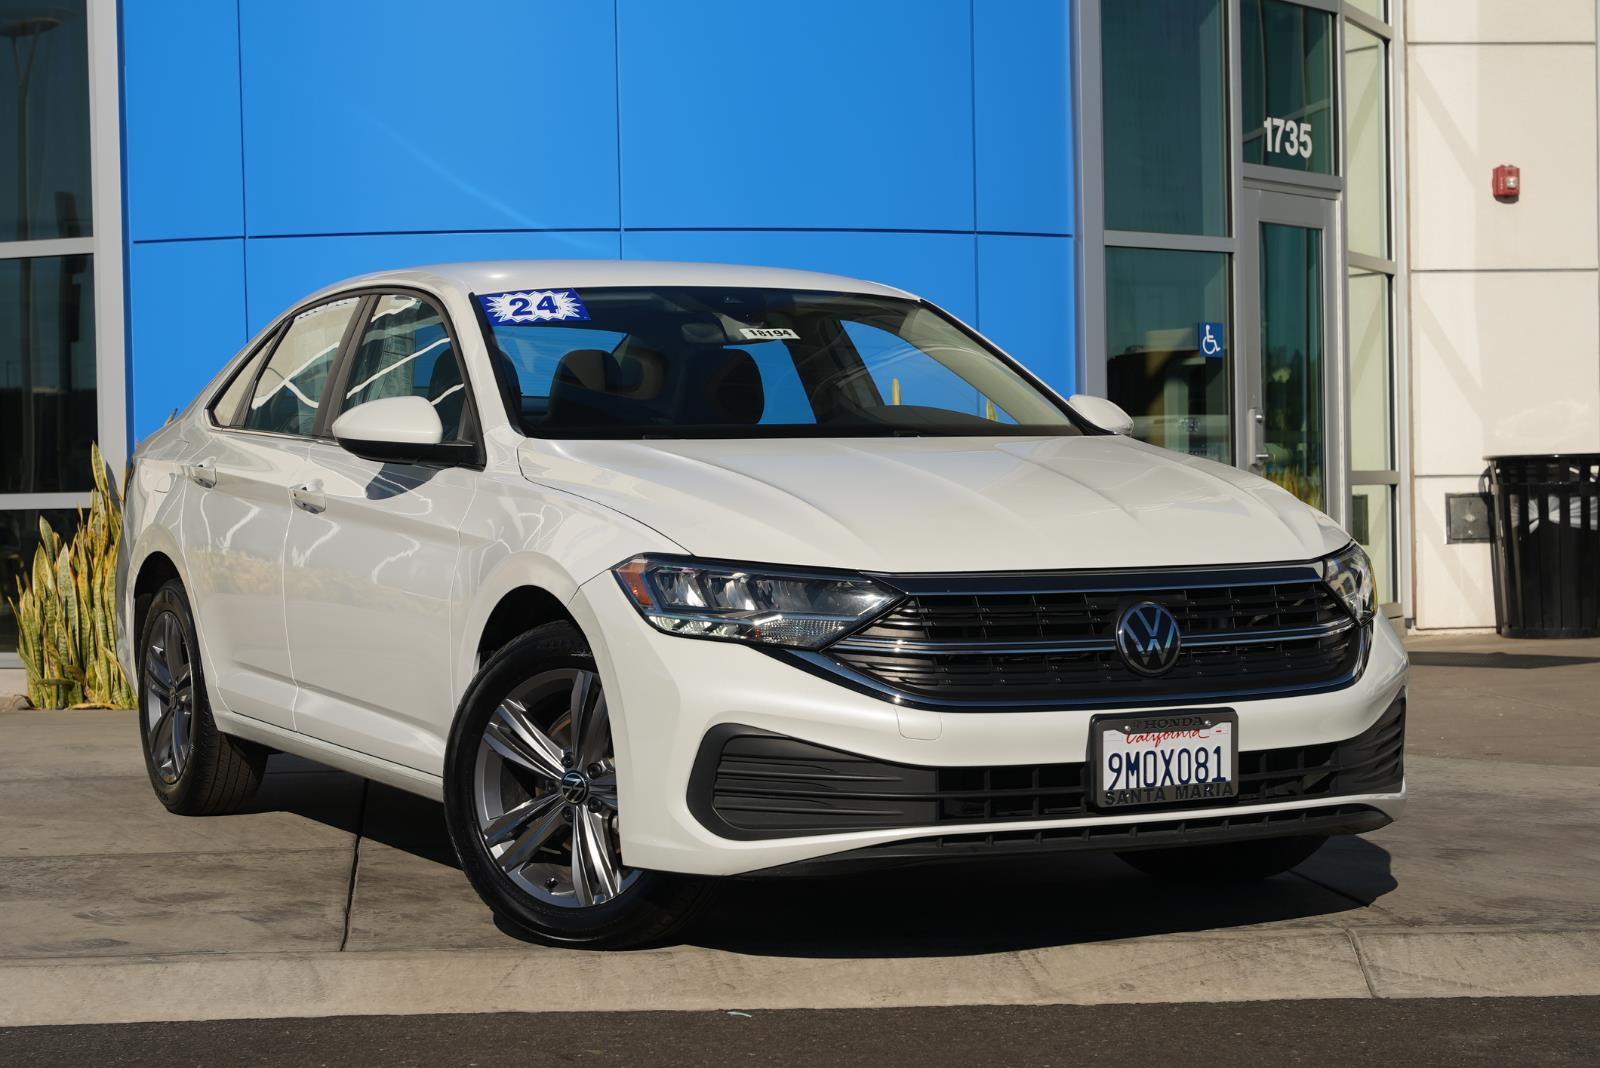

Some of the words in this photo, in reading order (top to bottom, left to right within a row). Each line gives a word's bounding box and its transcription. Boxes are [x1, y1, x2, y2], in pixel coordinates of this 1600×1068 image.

[1264, 117, 1312, 158] 1735
[509, 296, 559, 317] 24
[1144, 716, 1203, 729] HONDA
[1105, 787, 1165, 805] SANTA
[1176, 782, 1234, 799] MARIA
